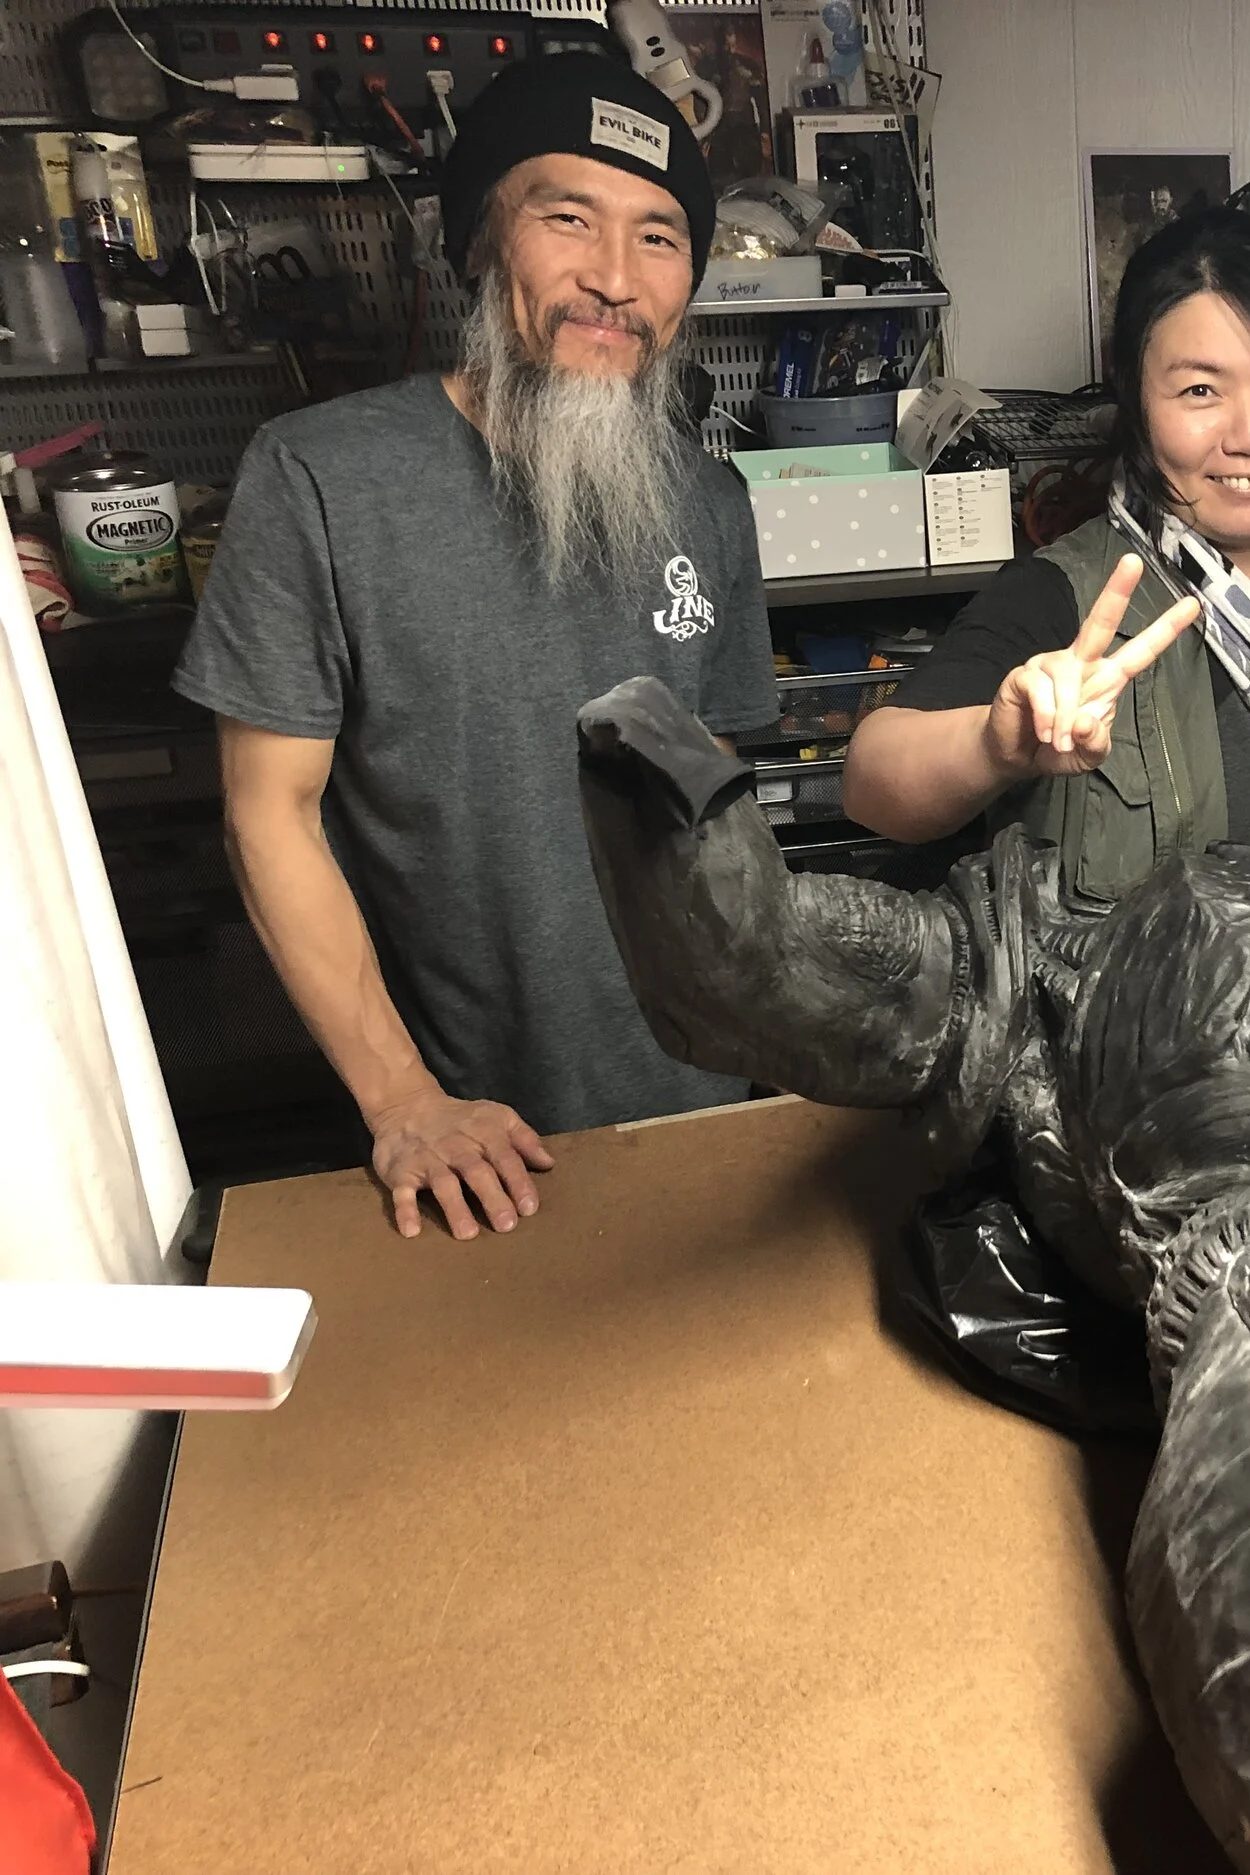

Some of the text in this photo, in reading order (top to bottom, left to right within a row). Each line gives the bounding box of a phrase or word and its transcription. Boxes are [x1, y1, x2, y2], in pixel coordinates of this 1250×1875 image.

[599, 115, 662, 149] EVIL BIKE
[91, 496, 160, 513] RUST-OLEUM
[96, 517, 167, 538] MAGNETIC
[124, 537, 148, 545] Primer
